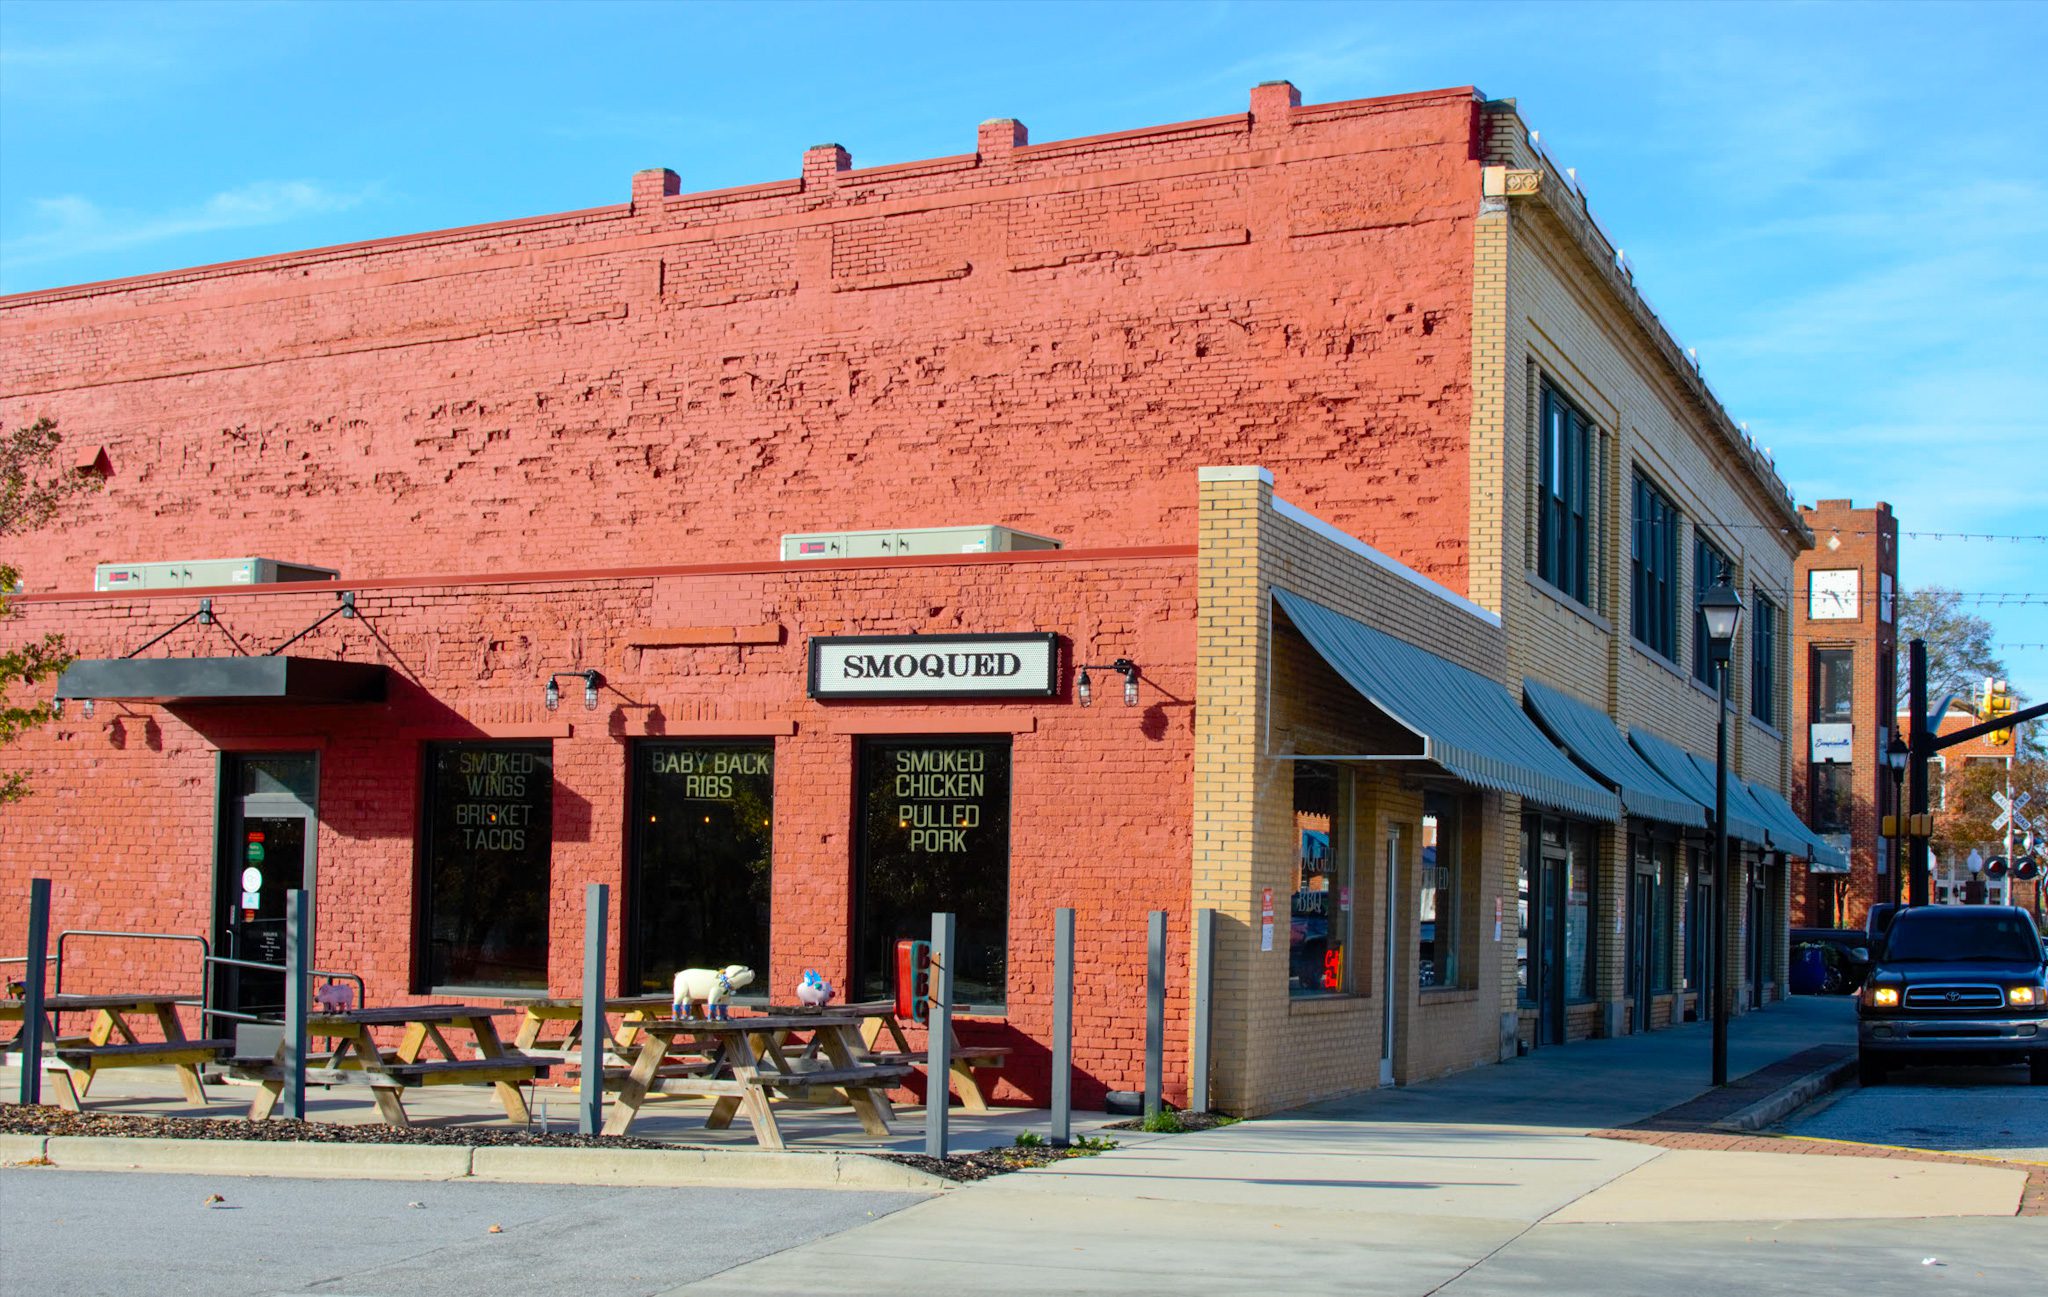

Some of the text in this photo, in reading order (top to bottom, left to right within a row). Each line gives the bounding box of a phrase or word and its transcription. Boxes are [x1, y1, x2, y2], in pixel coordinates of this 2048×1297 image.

[843, 653, 1021, 679] SMOQUED
[460, 752, 533, 774] SMOKED
[652, 751, 769, 775] BABY BACK
[896, 750, 984, 773] SMOKED
[466, 775, 526, 797] WINGS
[686, 775, 733, 798] RIBS
[895, 774, 984, 797] CHICKEN
[456, 804, 534, 826] BRISKET
[898, 804, 980, 828] PULLED
[462, 828, 526, 851] TACOS
[910, 829, 968, 852] PORK
[1298, 890, 1322, 913] BBQ
